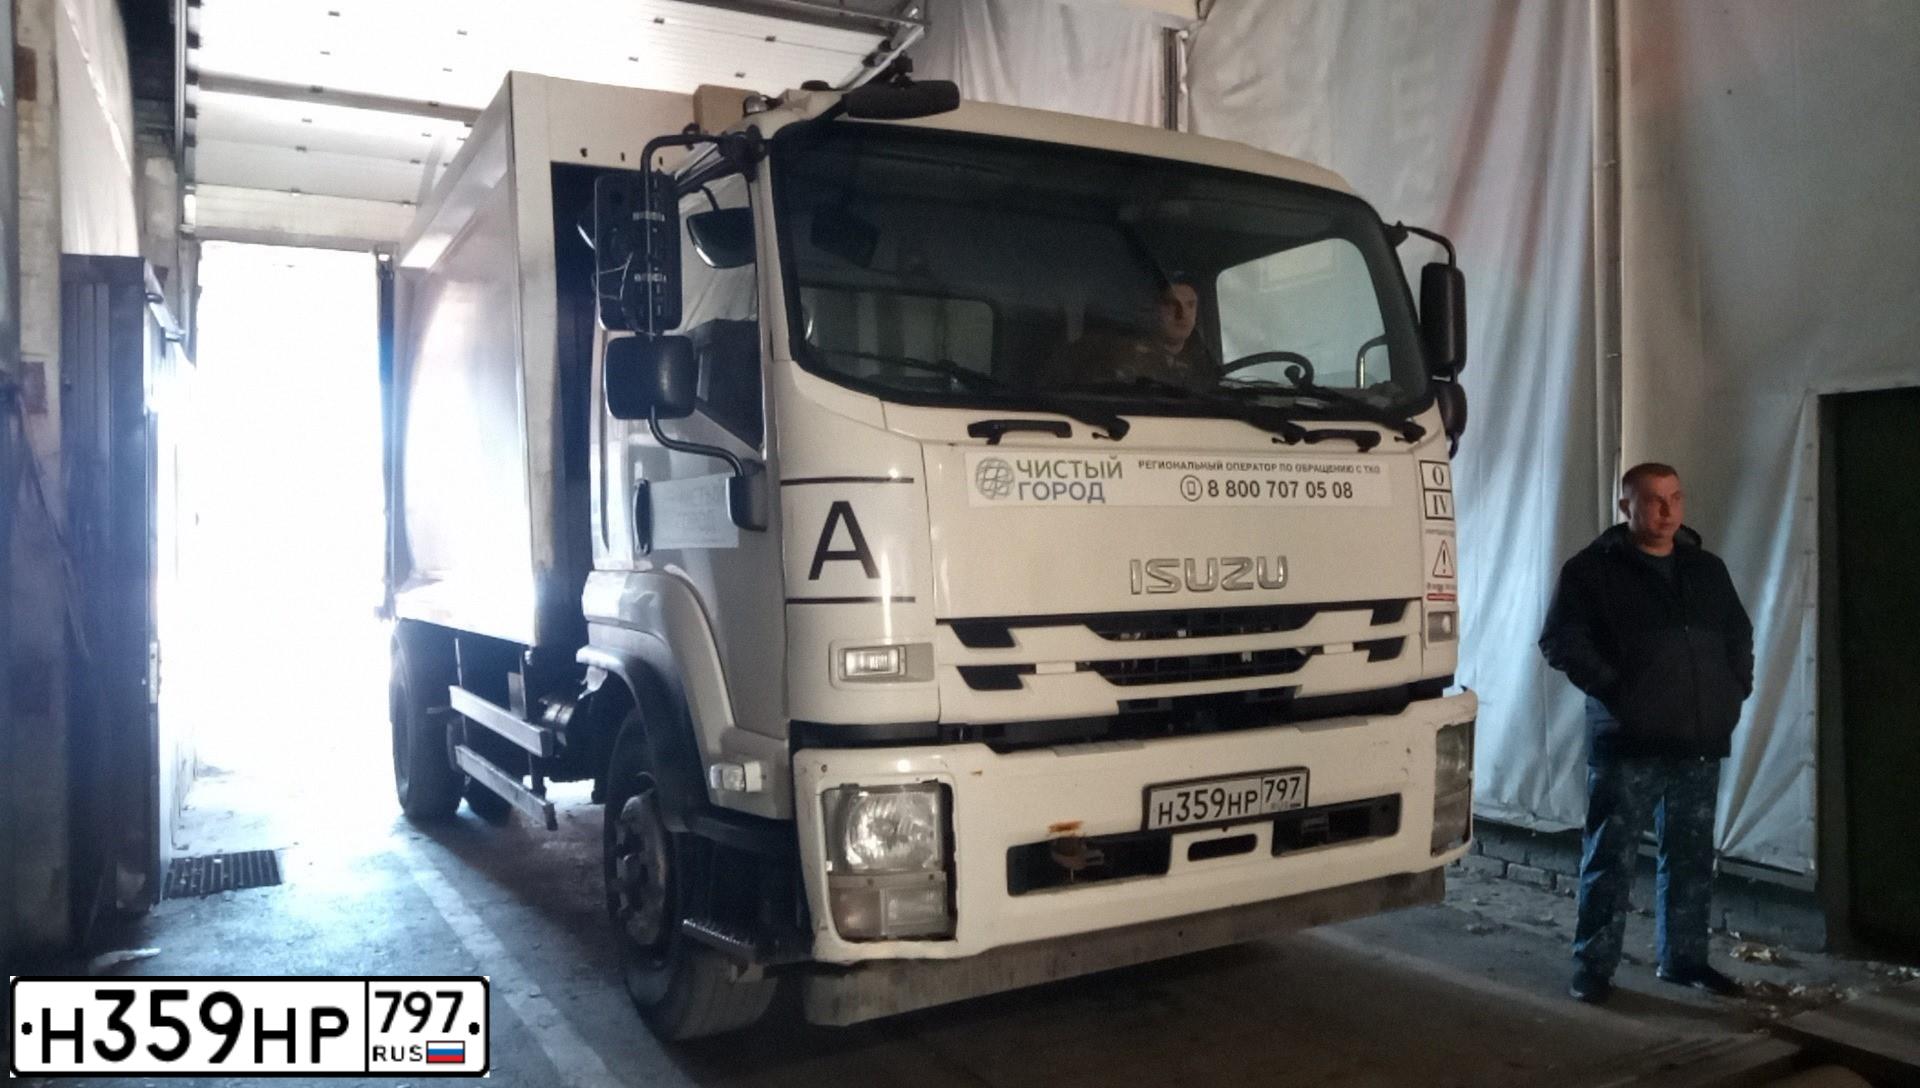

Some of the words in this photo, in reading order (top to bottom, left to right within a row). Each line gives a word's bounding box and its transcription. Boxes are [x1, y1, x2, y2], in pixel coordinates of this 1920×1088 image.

[1016, 454, 1123, 480] ЧИСТЫЙ
[1225, 462, 1278, 472] ОПЕРАТОР
[1279, 463, 1293, 472] ПО
[1018, 481, 1106, 504] ГОРОД
[1207, 479, 1219, 498] 8
[1225, 479, 1260, 498] 800
[1266, 480, 1299, 498] 707
[1305, 481, 1327, 498] 05
[1332, 481, 1353, 499] 08
[1433, 494, 1449, 515] IV
[1129, 555, 1289, 595] ISUZU
[1263, 775, 1301, 803] 797
